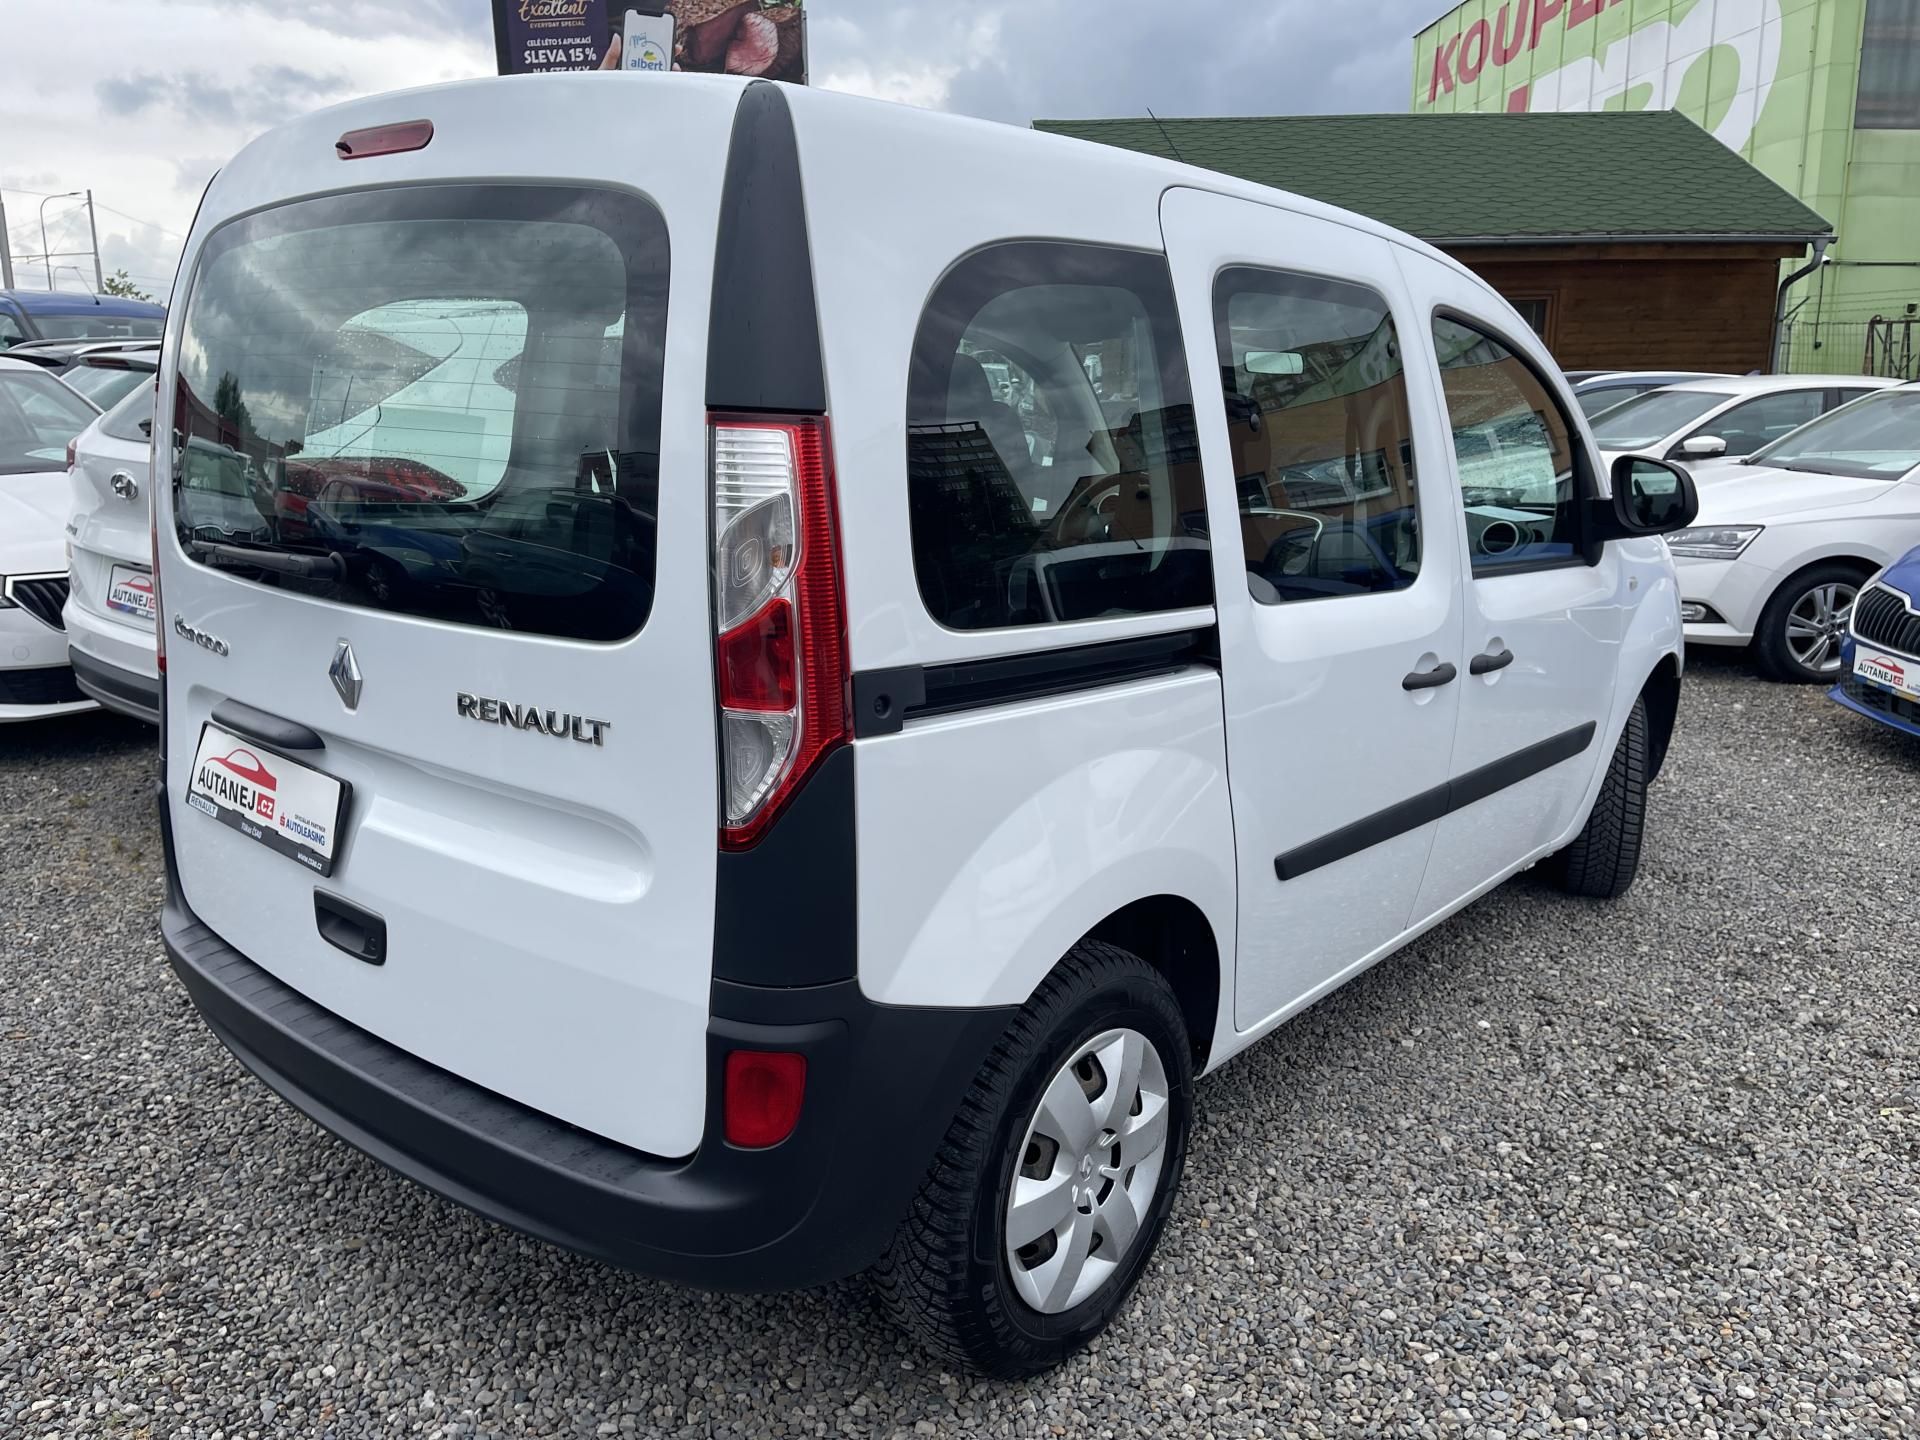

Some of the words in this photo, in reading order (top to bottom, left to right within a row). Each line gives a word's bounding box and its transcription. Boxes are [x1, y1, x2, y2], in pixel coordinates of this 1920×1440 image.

[523, 48, 567, 64] SLEVA
[630, 58, 664, 71] albert
[456, 690, 611, 747] RENAULT
[190, 795, 217, 815] RENAULT
[286, 818, 325, 846] AUTOLEASING
